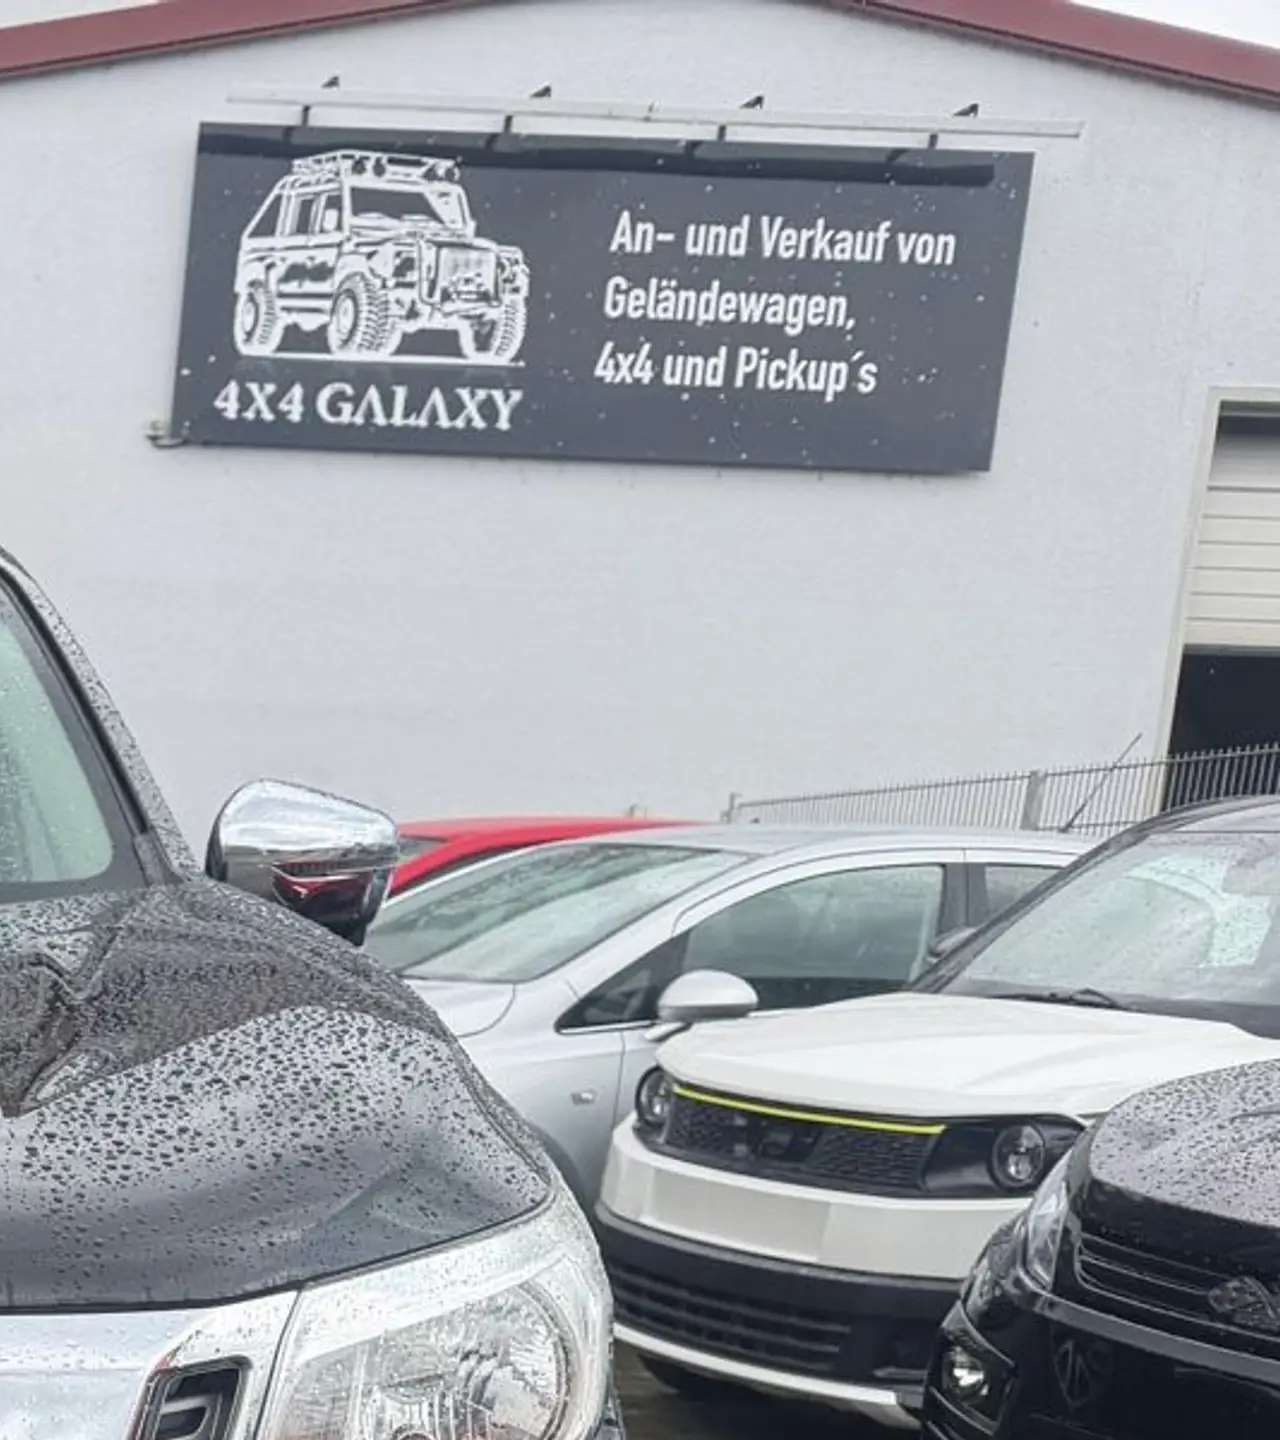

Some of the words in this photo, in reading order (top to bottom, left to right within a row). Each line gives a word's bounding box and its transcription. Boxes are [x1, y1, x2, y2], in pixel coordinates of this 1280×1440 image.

[609, 209, 675, 254] An-
[684, 214, 750, 258] und
[760, 215, 893, 263] Verkauf
[897, 231, 956, 266] von
[603, 275, 856, 336] Geländewagen,
[594, 341, 654, 386] 4x4
[662, 346, 727, 388] und
[213, 379, 306, 424] 4X4
[315, 381, 524, 431] GALAXY
